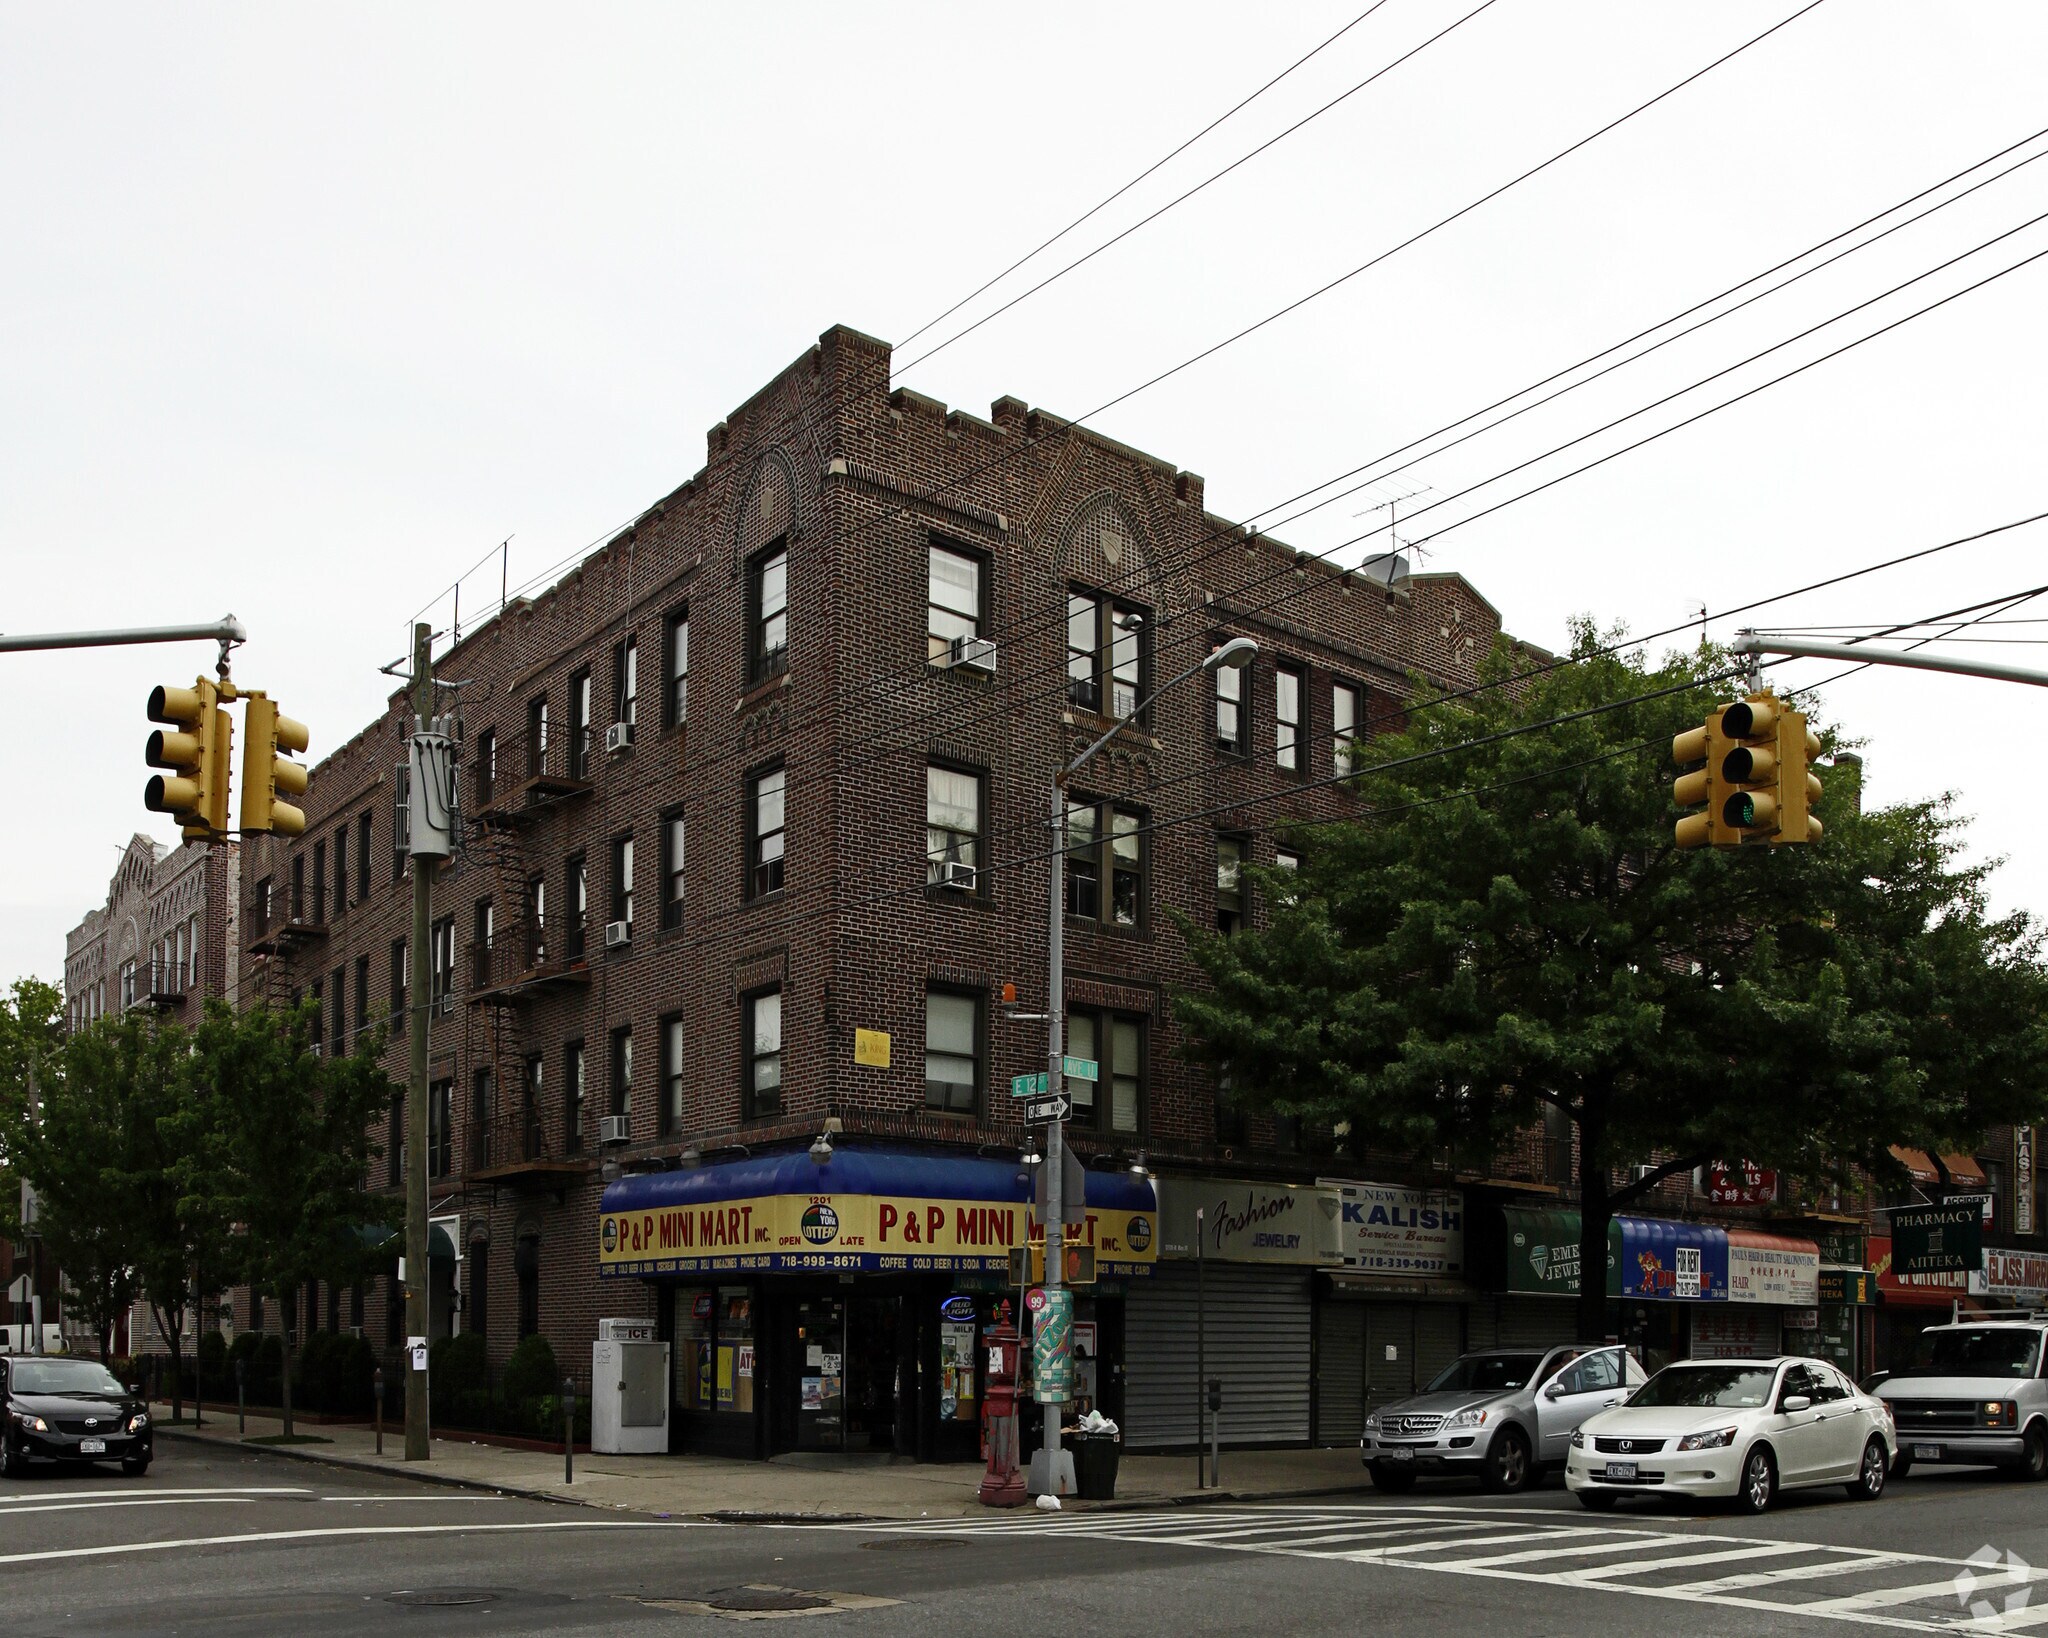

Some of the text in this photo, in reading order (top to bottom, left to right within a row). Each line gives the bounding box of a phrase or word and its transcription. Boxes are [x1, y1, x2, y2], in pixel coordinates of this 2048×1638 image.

[1067, 1059, 1094, 1078] AVE U
[1016, 1079, 1022, 1094] E
[1027, 1077, 1037, 1092] 12
[1050, 1102, 1064, 1113] WAY
[809, 1196, 831, 1204] 1201
[1364, 1190, 1397, 1201] NEW
[1946, 1196, 1990, 1205] ACCIDENT
[819, 1207, 834, 1215] NEW
[1342, 1202, 1460, 1231] KALISH
[820, 1215, 837, 1226] YORK
[1212, 1191, 1294, 1249] Fashion
[1896, 1210, 1976, 1227] PHARMACY
[619, 1218, 629, 1251] P
[632, 1222, 641, 1251] &
[644, 1215, 654, 1250] P
[660, 1211, 694, 1249] MINI
[700, 1207, 752, 1247] MART
[755, 1227, 771, 1242] INC.
[803, 1225, 838, 1240] LOTTERY
[879, 1204, 1122, 1251] P & P MINI MRT INC.
[779, 1236, 865, 1246] OPEN LATE
[1253, 1233, 1300, 1249] JEWELRY
[1358, 1227, 1447, 1243] Service Bureau
[781, 1256, 861, 1267] 718-998-8671
[880, 1257, 907, 1269] COFFEE
[913, 1257, 931, 1269] COLD
[934, 1258, 951, 1269] BEER
[954, 1258, 960, 1269] &
[963, 1259, 980, 1270] SODA
[1361, 1256, 1443, 1270] 718-339-9037
[1687, 1250, 1699, 1273] RENT
[1114, 1263, 1132, 1275] PHONE
[1135, 1264, 1150, 1276] CARD
[1989, 1257, 2021, 1286] GLASS
[1732, 1276, 1749, 1289] HAIR
[628, 1329, 648, 1339] ICE
[953, 1325, 974, 1333] MILK
